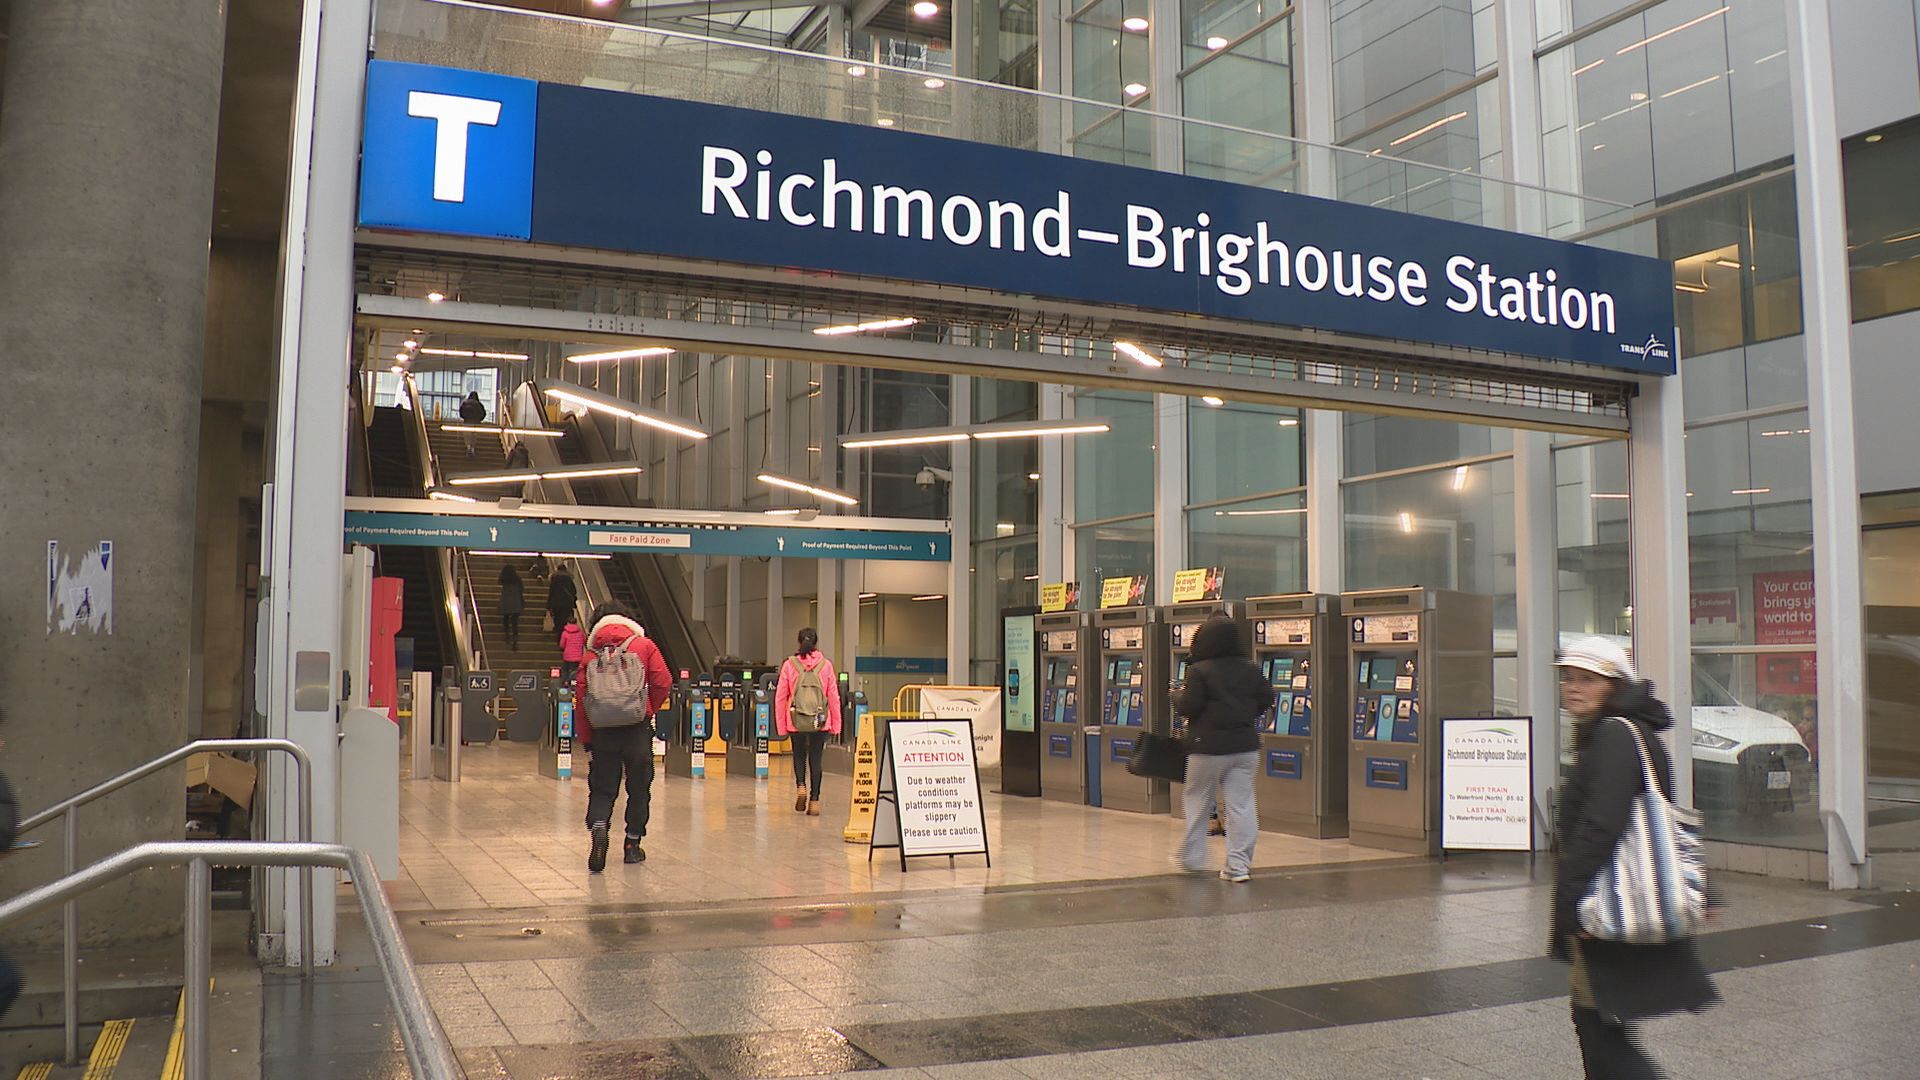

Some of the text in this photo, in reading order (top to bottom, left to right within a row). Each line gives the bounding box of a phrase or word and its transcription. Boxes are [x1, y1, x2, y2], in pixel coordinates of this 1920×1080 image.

[408, 91, 501, 202] T
[1445, 254, 1615, 334] Station
[363, 527, 389, 535] Payment
[390, 528, 416, 536] Required
[417, 529, 439, 537] Beyond
[609, 534, 671, 545] Fare Paid Zone
[802, 541, 816, 549] Proof
[823, 542, 845, 550] Payment
[846, 543, 868, 551] Required
[1763, 580, 1815, 593] Your car
[1763, 595, 1801, 610] brings
[1764, 610, 1813, 624] world to
[936, 705, 963, 713] CANADA
[974, 735, 993, 744] onight
[904, 752, 965, 763] ATTENTION
[1447, 749, 1527, 762] Richmond Brighouse Station
[907, 776, 966, 785] Due to weather
[918, 788, 958, 797] conditions
[905, 800, 974, 812] platforms may be
[925, 812, 957, 823] slippery
[904, 827, 980, 838] Please use caution.
